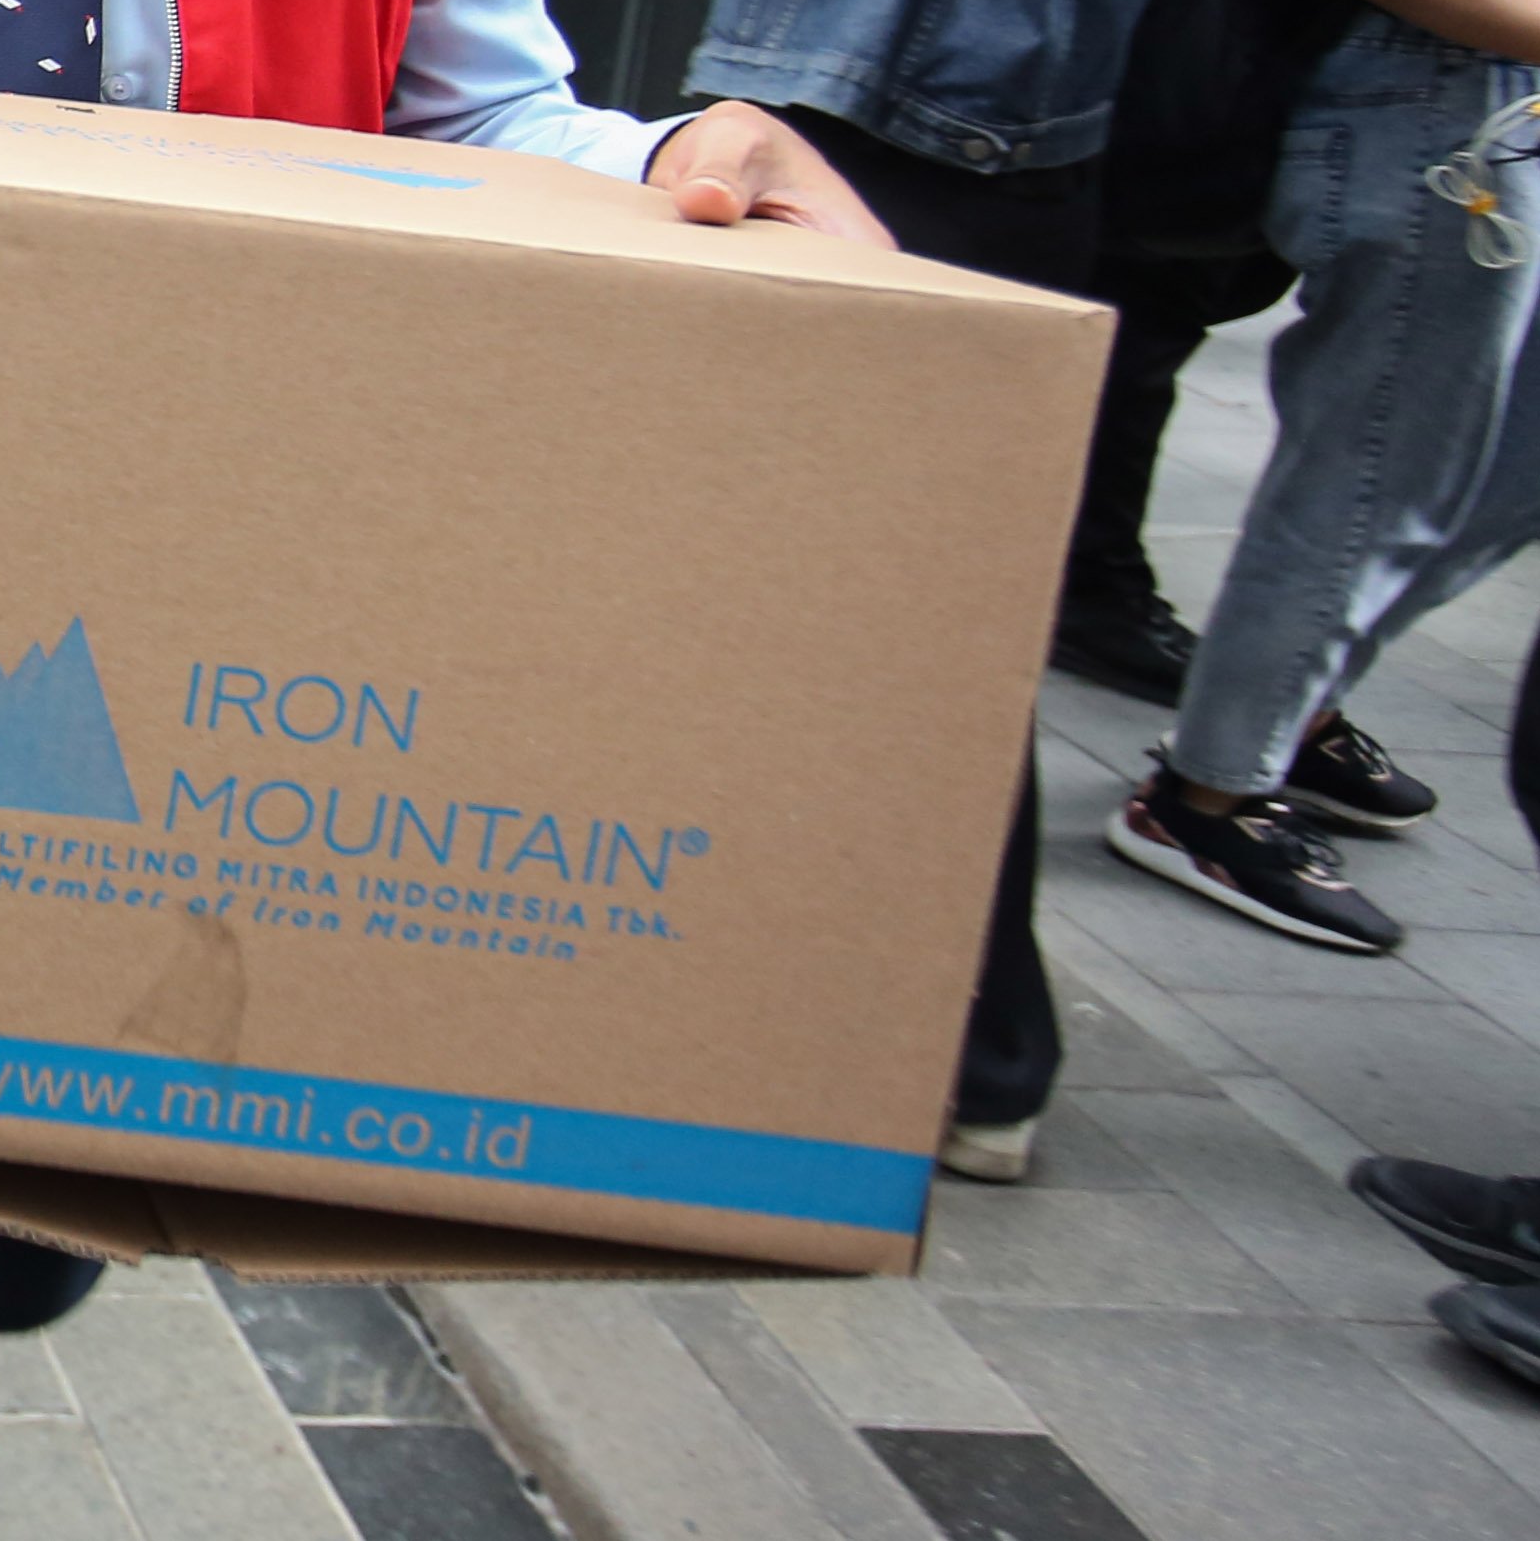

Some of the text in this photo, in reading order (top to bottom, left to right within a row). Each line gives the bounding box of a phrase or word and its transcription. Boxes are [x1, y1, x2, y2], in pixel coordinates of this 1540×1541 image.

[183, 661, 420, 752] IRON
[185, 891, 236, 917] of
[253, 897, 342, 932] Iron
[364, 911, 577, 961] Mountain
[217, 858, 339, 897] MITRA
[357, 875, 586, 929] INDONESIA
[606, 905, 684, 941] Tbk.
